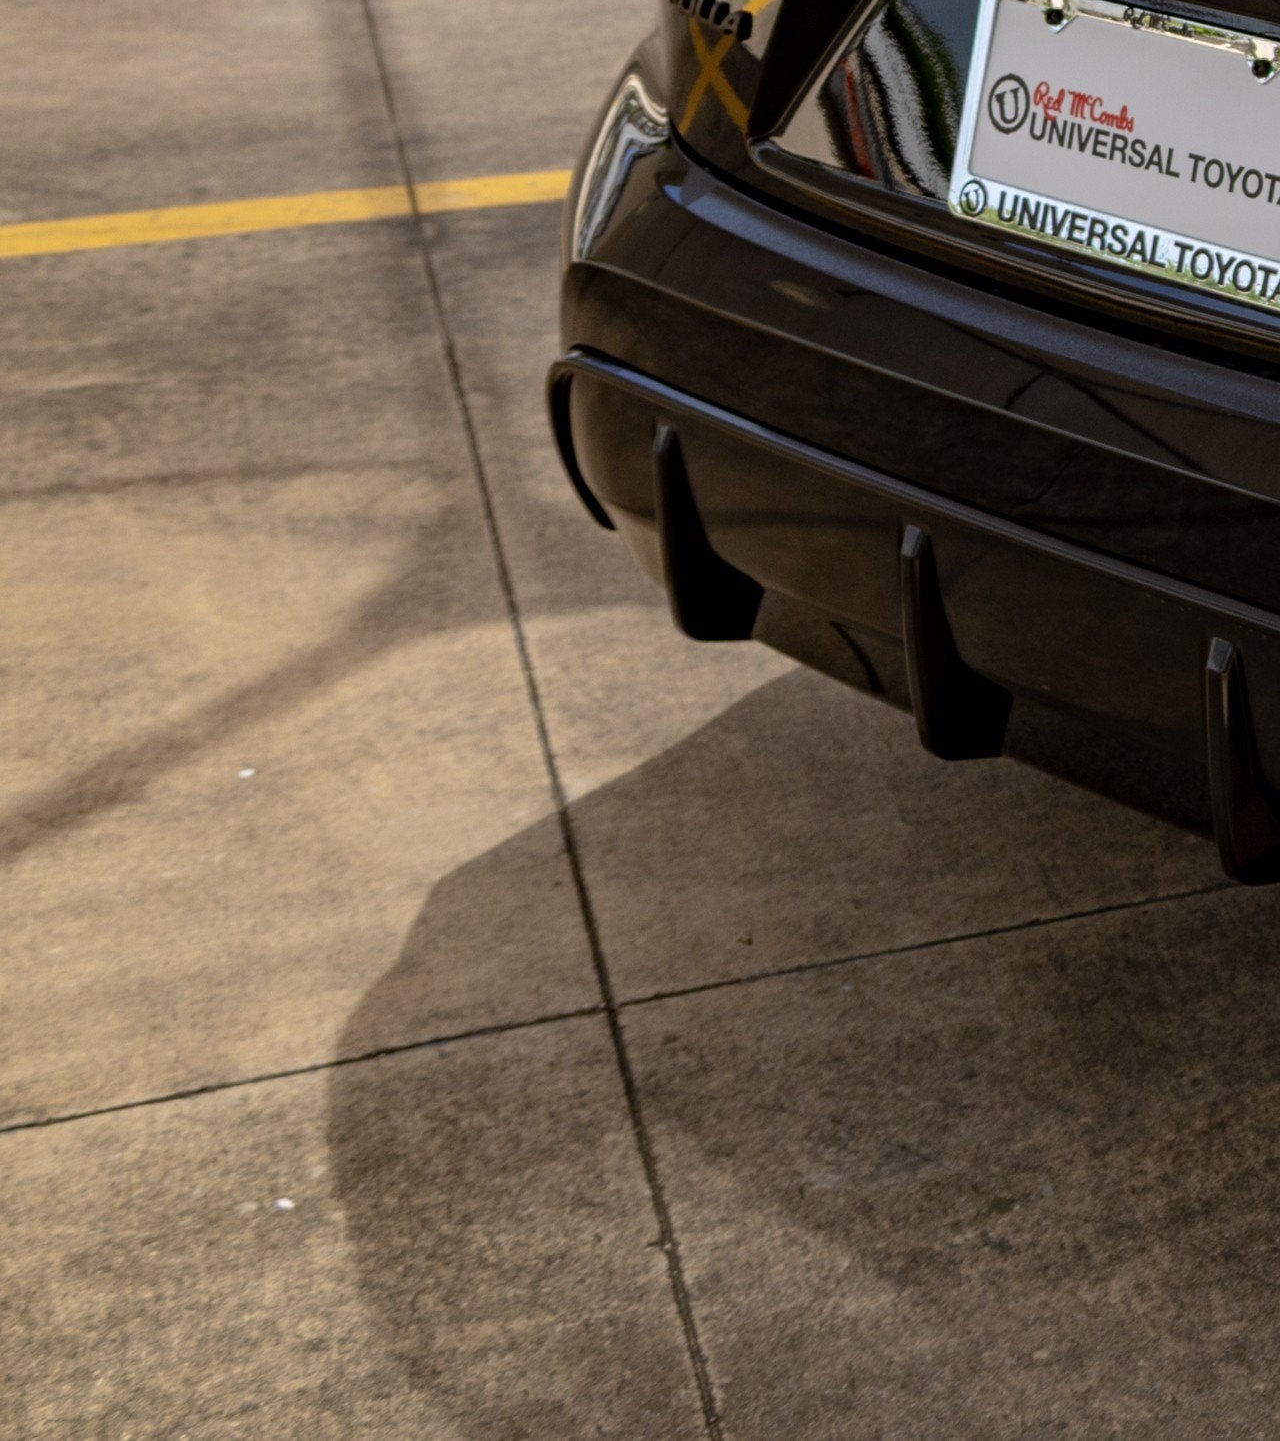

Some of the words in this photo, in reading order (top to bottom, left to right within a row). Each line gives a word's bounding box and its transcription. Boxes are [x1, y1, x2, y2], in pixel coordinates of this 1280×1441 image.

[1033, 80, 1067, 122] Red
[1068, 88, 1135, 133] McCombs
[1028, 115, 1181, 179] UNIVERSAL
[997, 191, 1168, 268] UNIVERSAL
